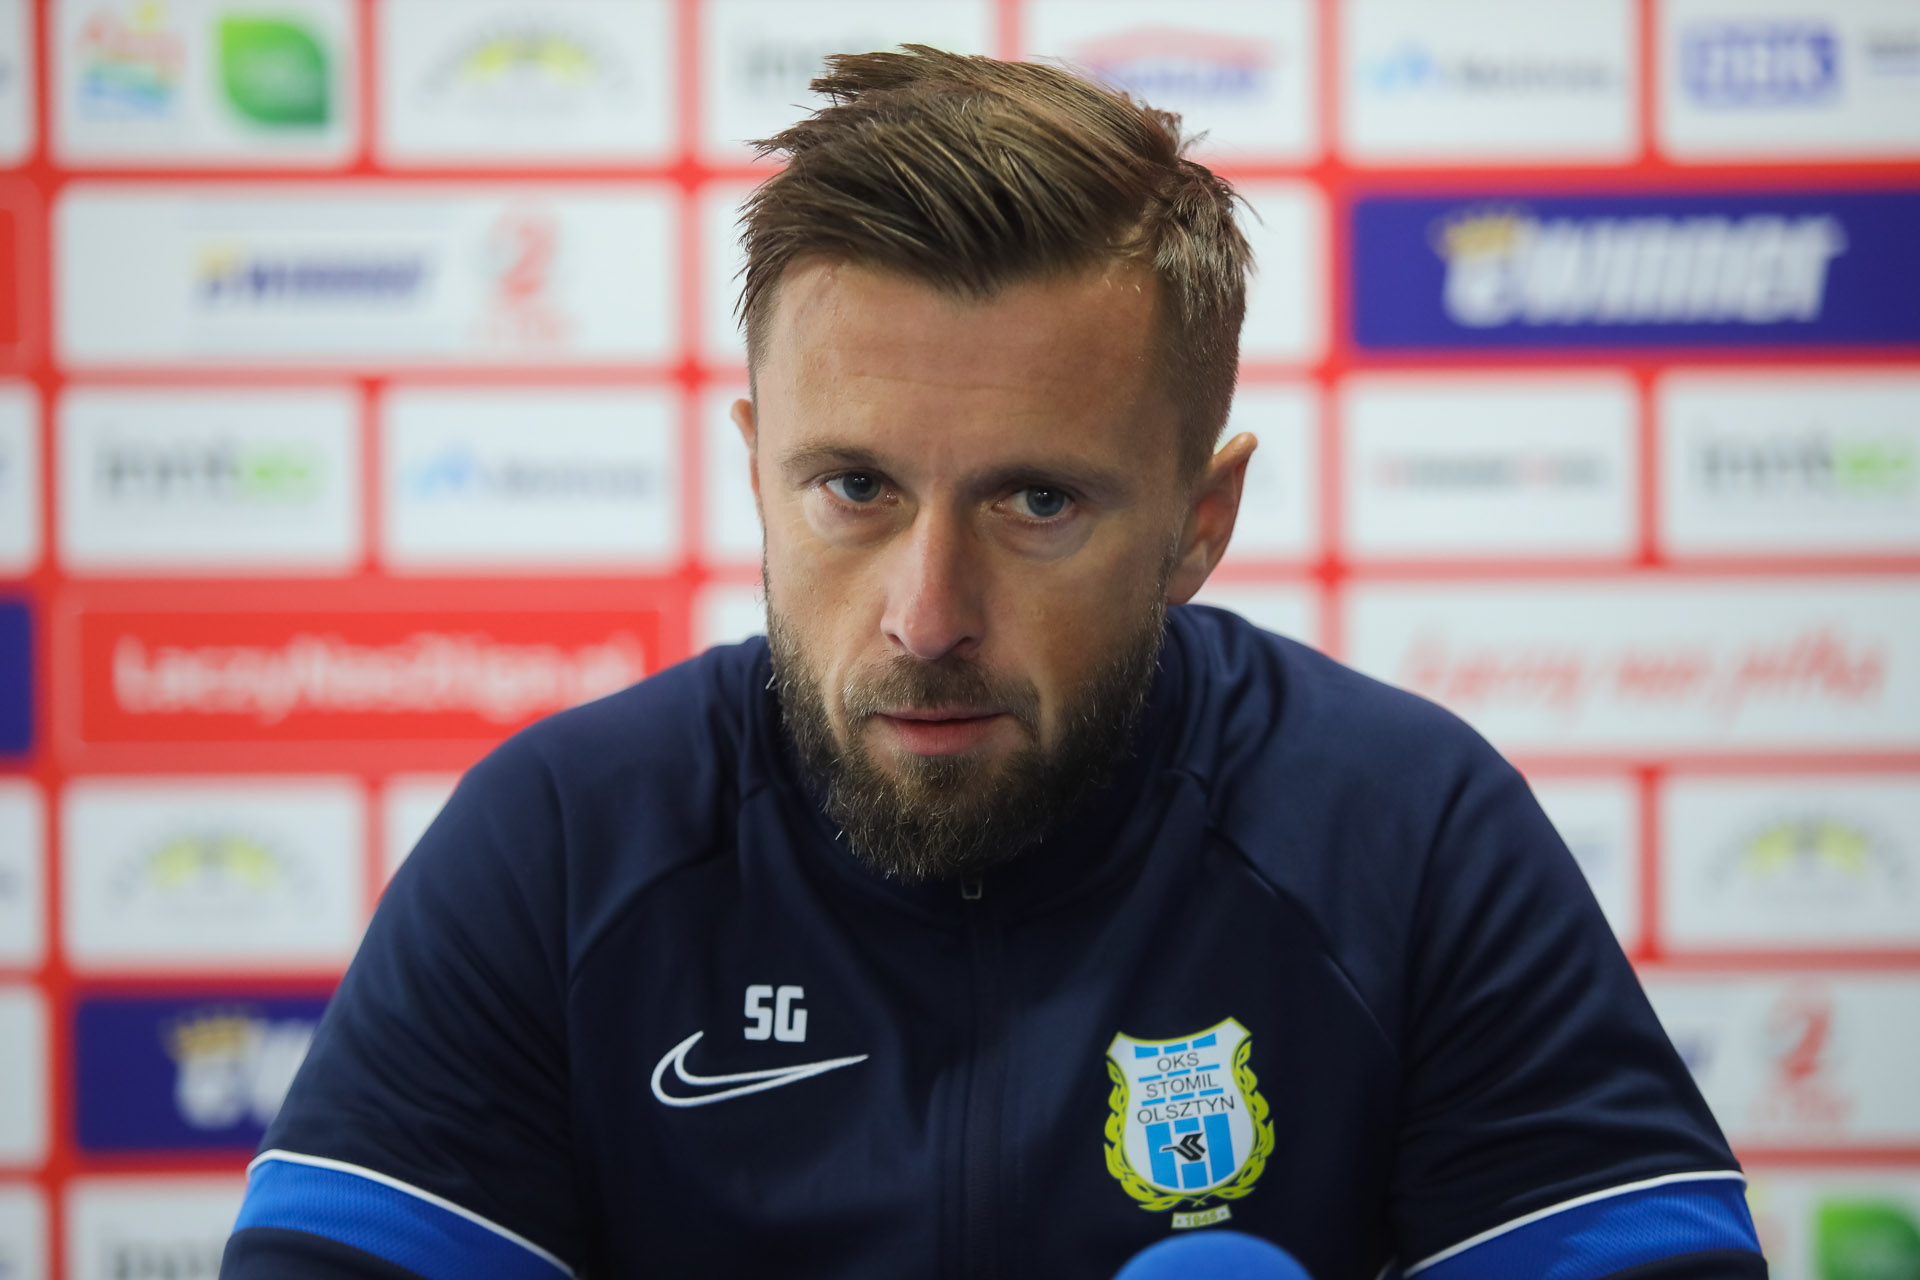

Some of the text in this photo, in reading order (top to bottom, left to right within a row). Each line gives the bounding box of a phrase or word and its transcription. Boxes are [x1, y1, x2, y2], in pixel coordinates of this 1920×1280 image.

[744, 984, 808, 1042] SG
[1157, 1052, 1200, 1073] OKS
[1146, 1073, 1219, 1098] STOMIL
[1137, 1096, 1235, 1125] OLSZTYN
